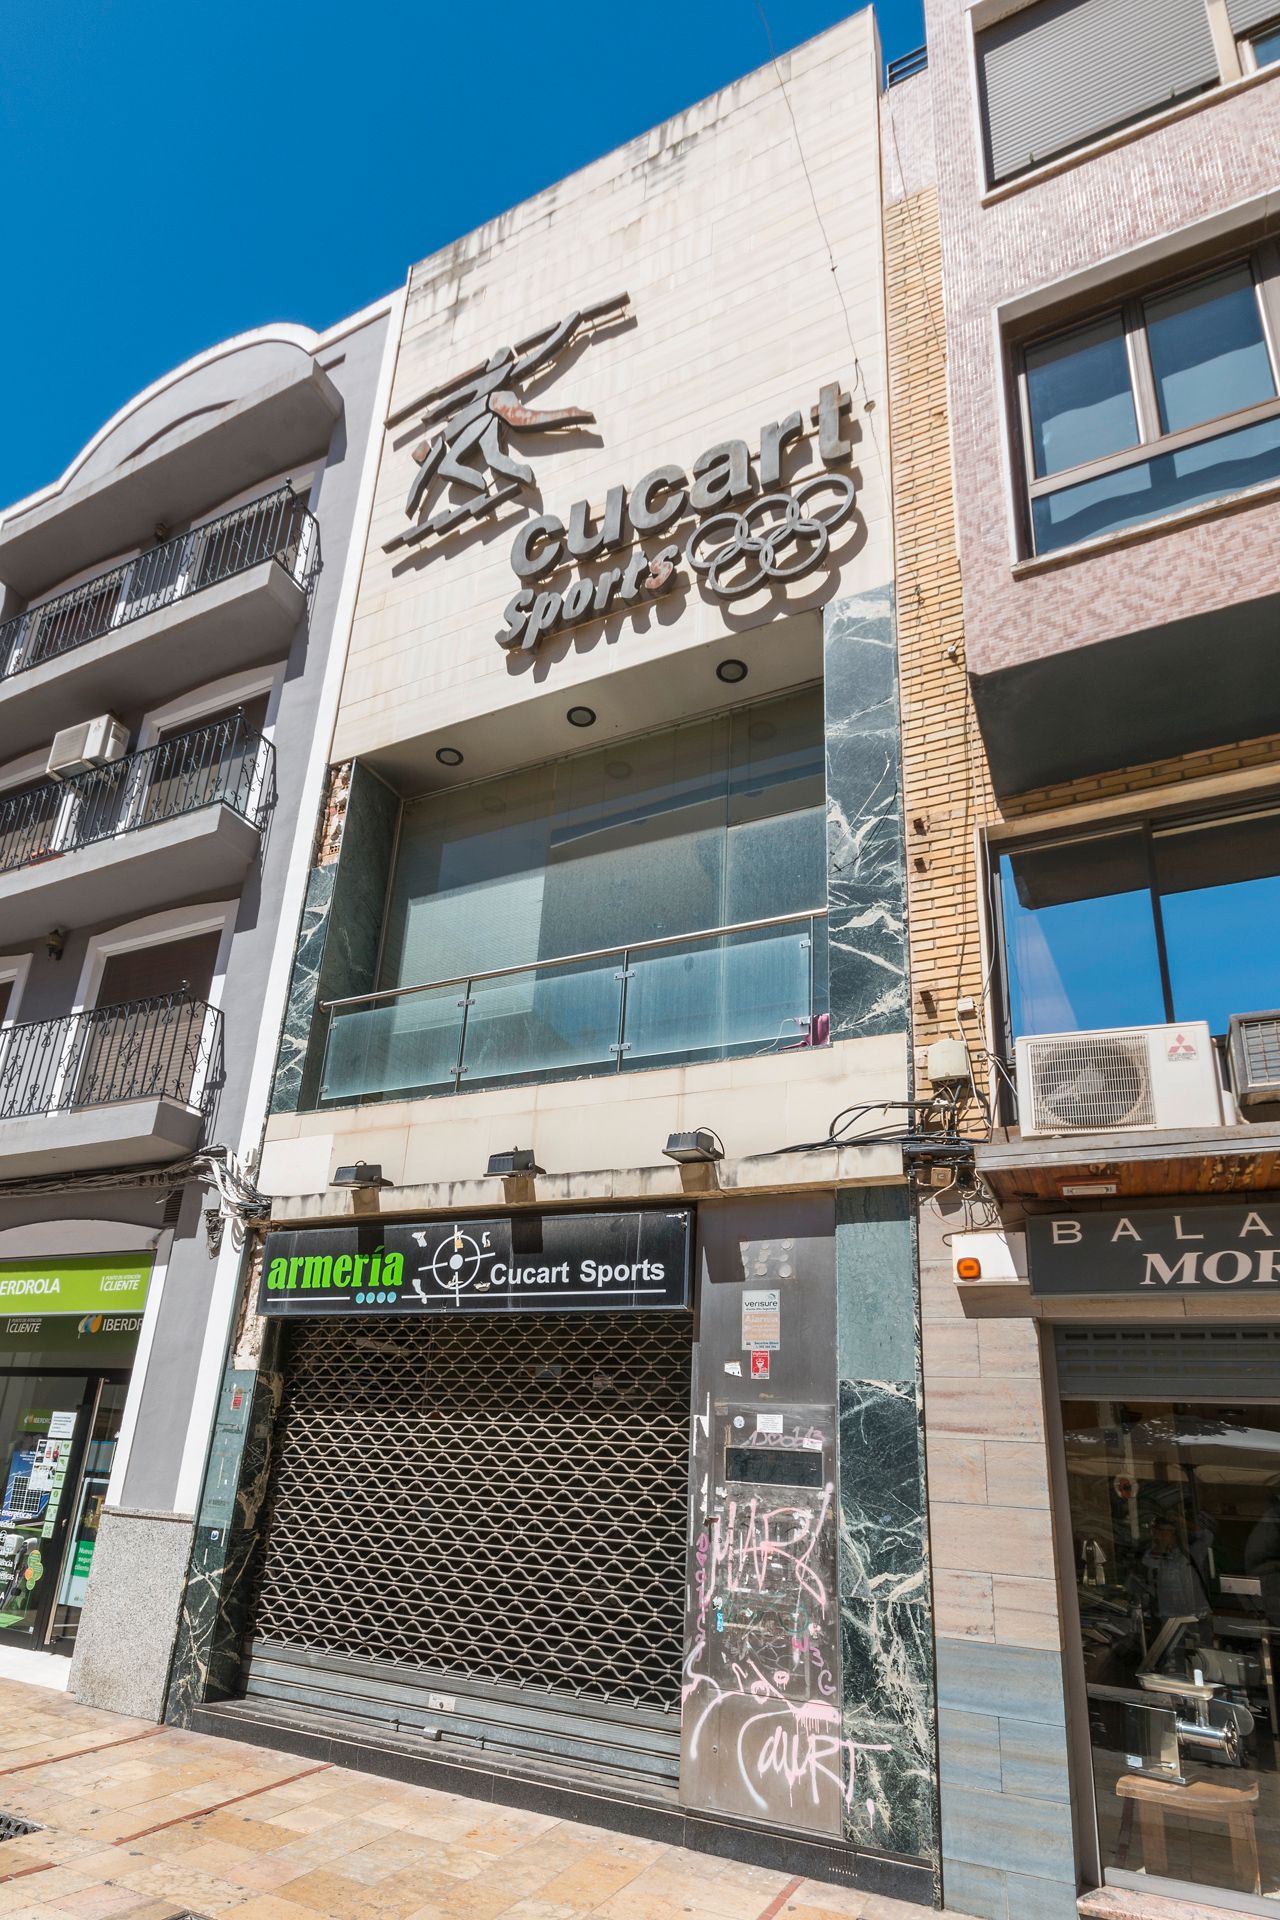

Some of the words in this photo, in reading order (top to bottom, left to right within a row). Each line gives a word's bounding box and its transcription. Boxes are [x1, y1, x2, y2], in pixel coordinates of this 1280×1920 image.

[509, 381, 853, 582] cucart
[267, 1245, 404, 1290] armería
[490, 1261, 570, 1285] Cucart
[579, 1258, 665, 1288] Sports
[103, 1280, 140, 1291] CLIENTE
[744, 1300, 778, 1308] verisure
[9, 1322, 41, 1333] CLIENTE
